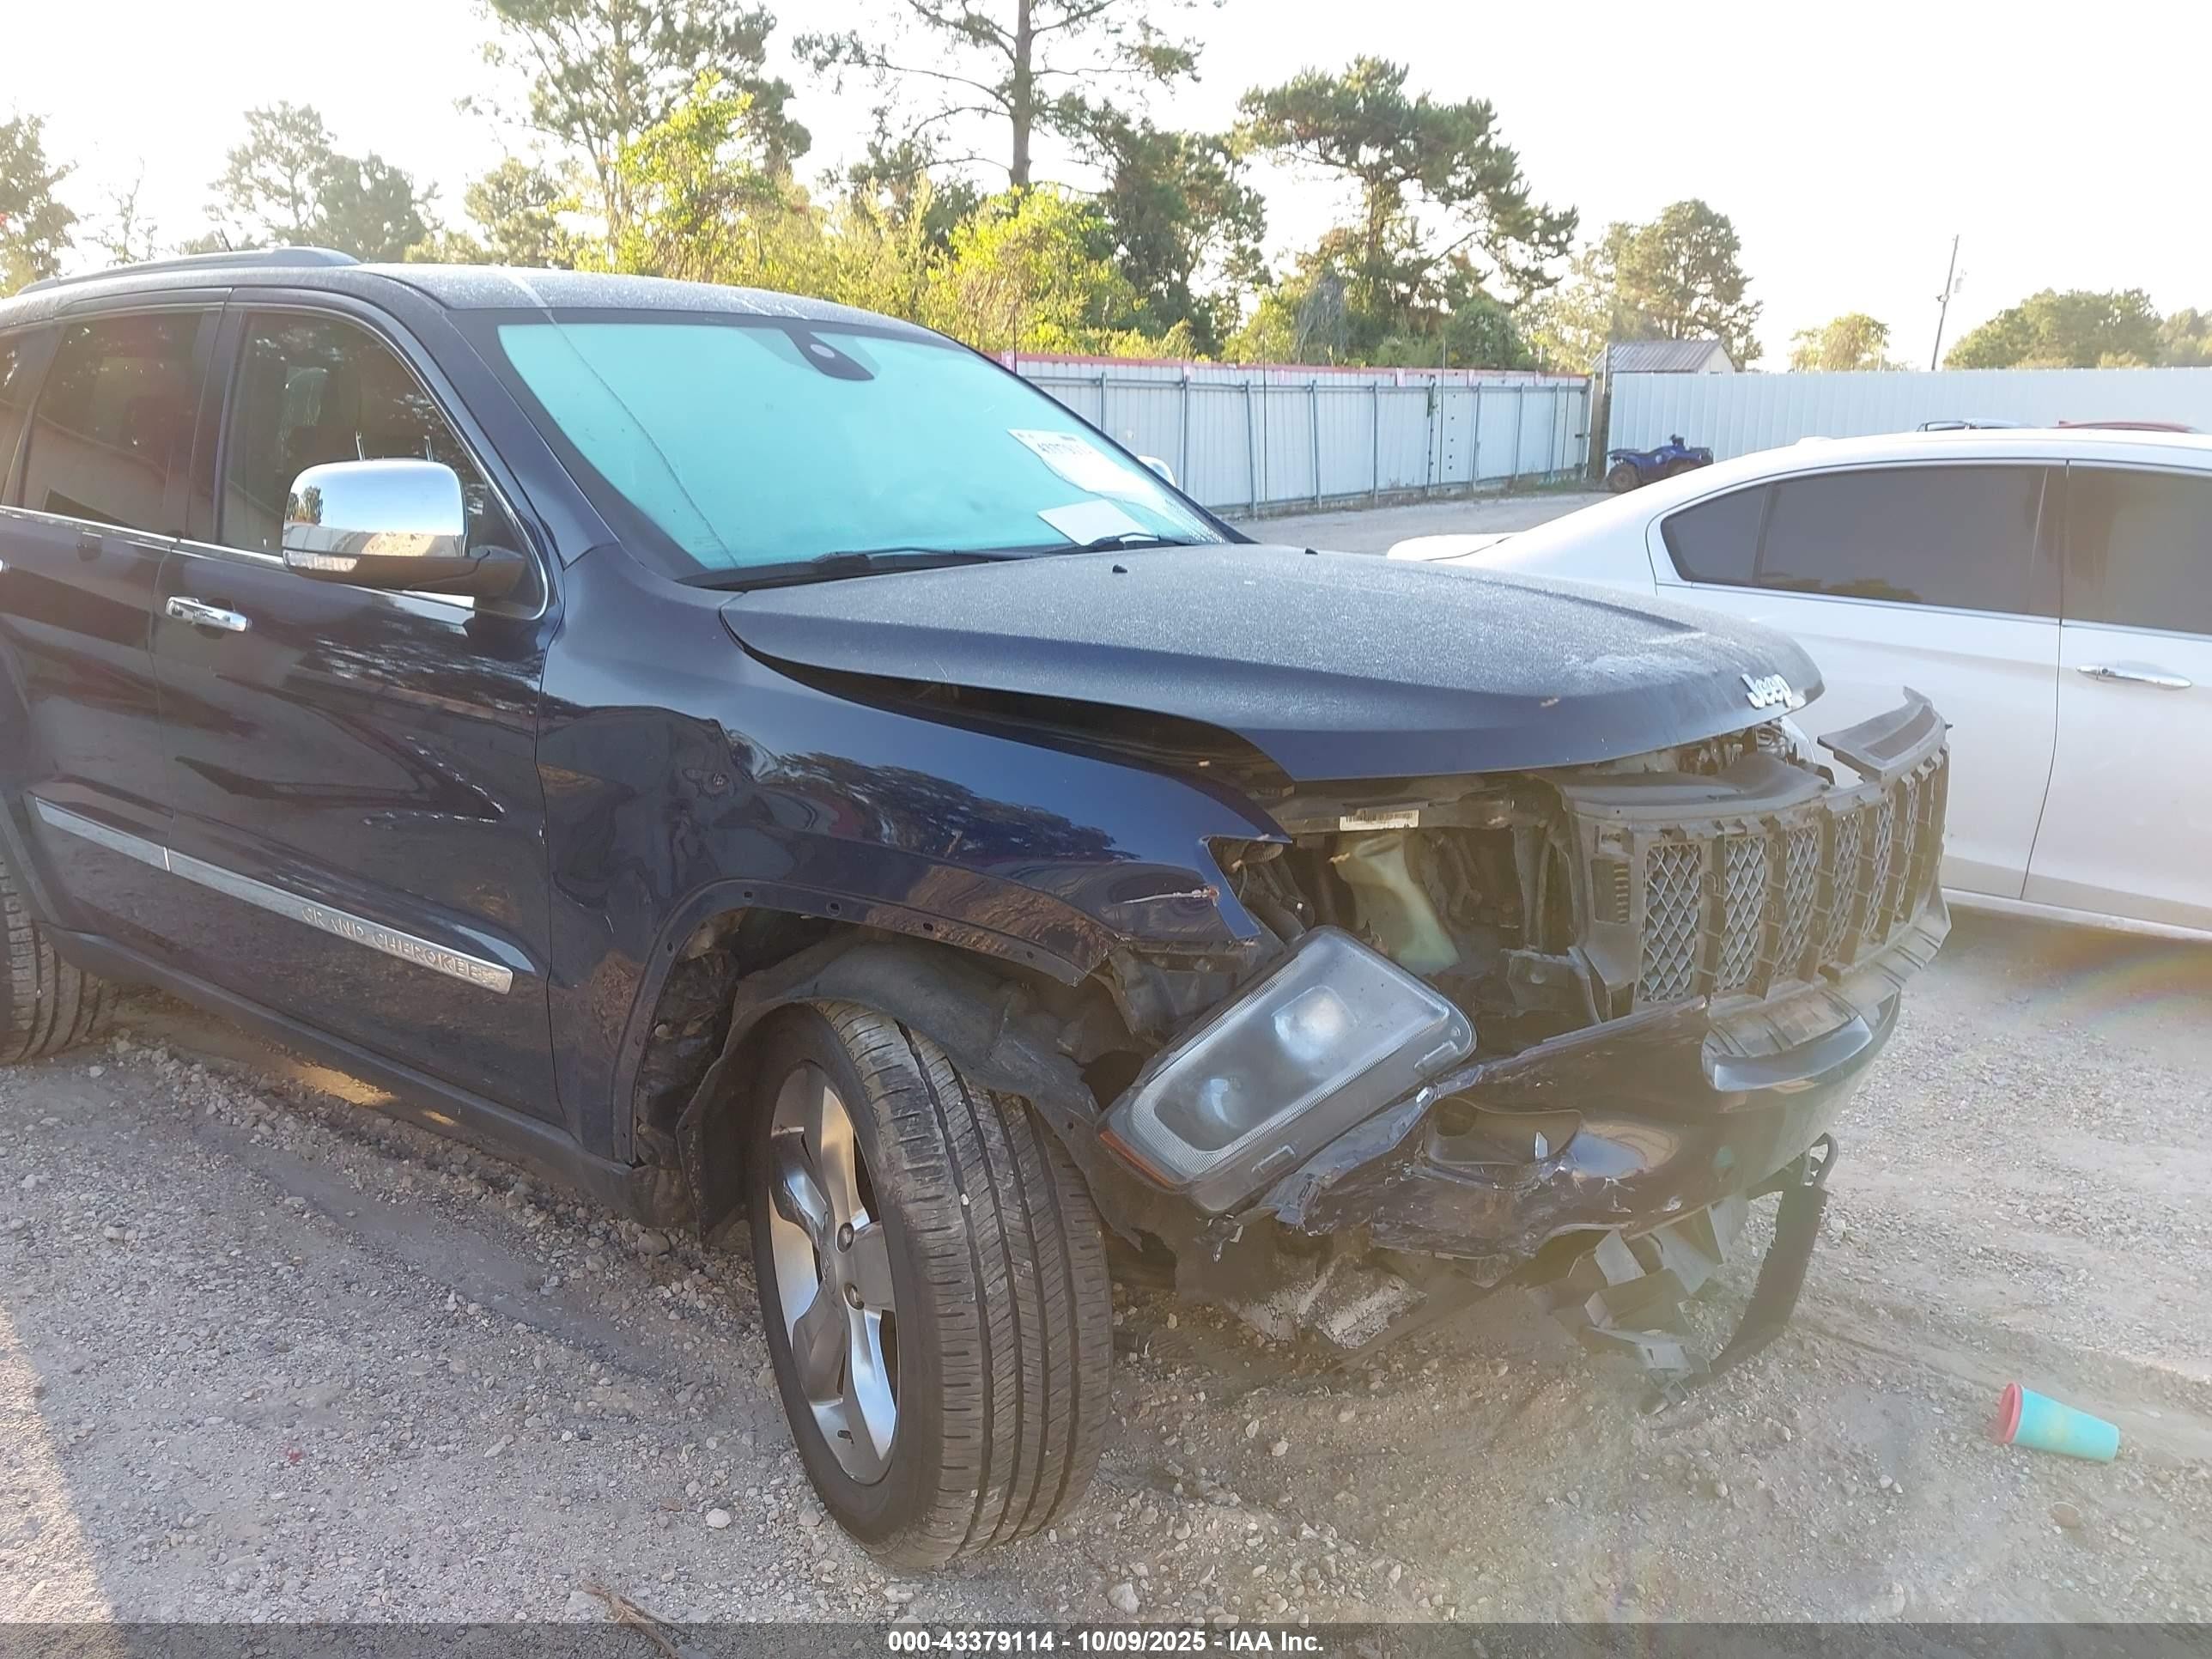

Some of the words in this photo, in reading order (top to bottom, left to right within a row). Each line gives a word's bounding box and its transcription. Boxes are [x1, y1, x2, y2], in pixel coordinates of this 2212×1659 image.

[1741, 673, 1793, 709] Jeep
[301, 906, 364, 938] GRAND
[372, 932, 479, 979] CHEROKEE
